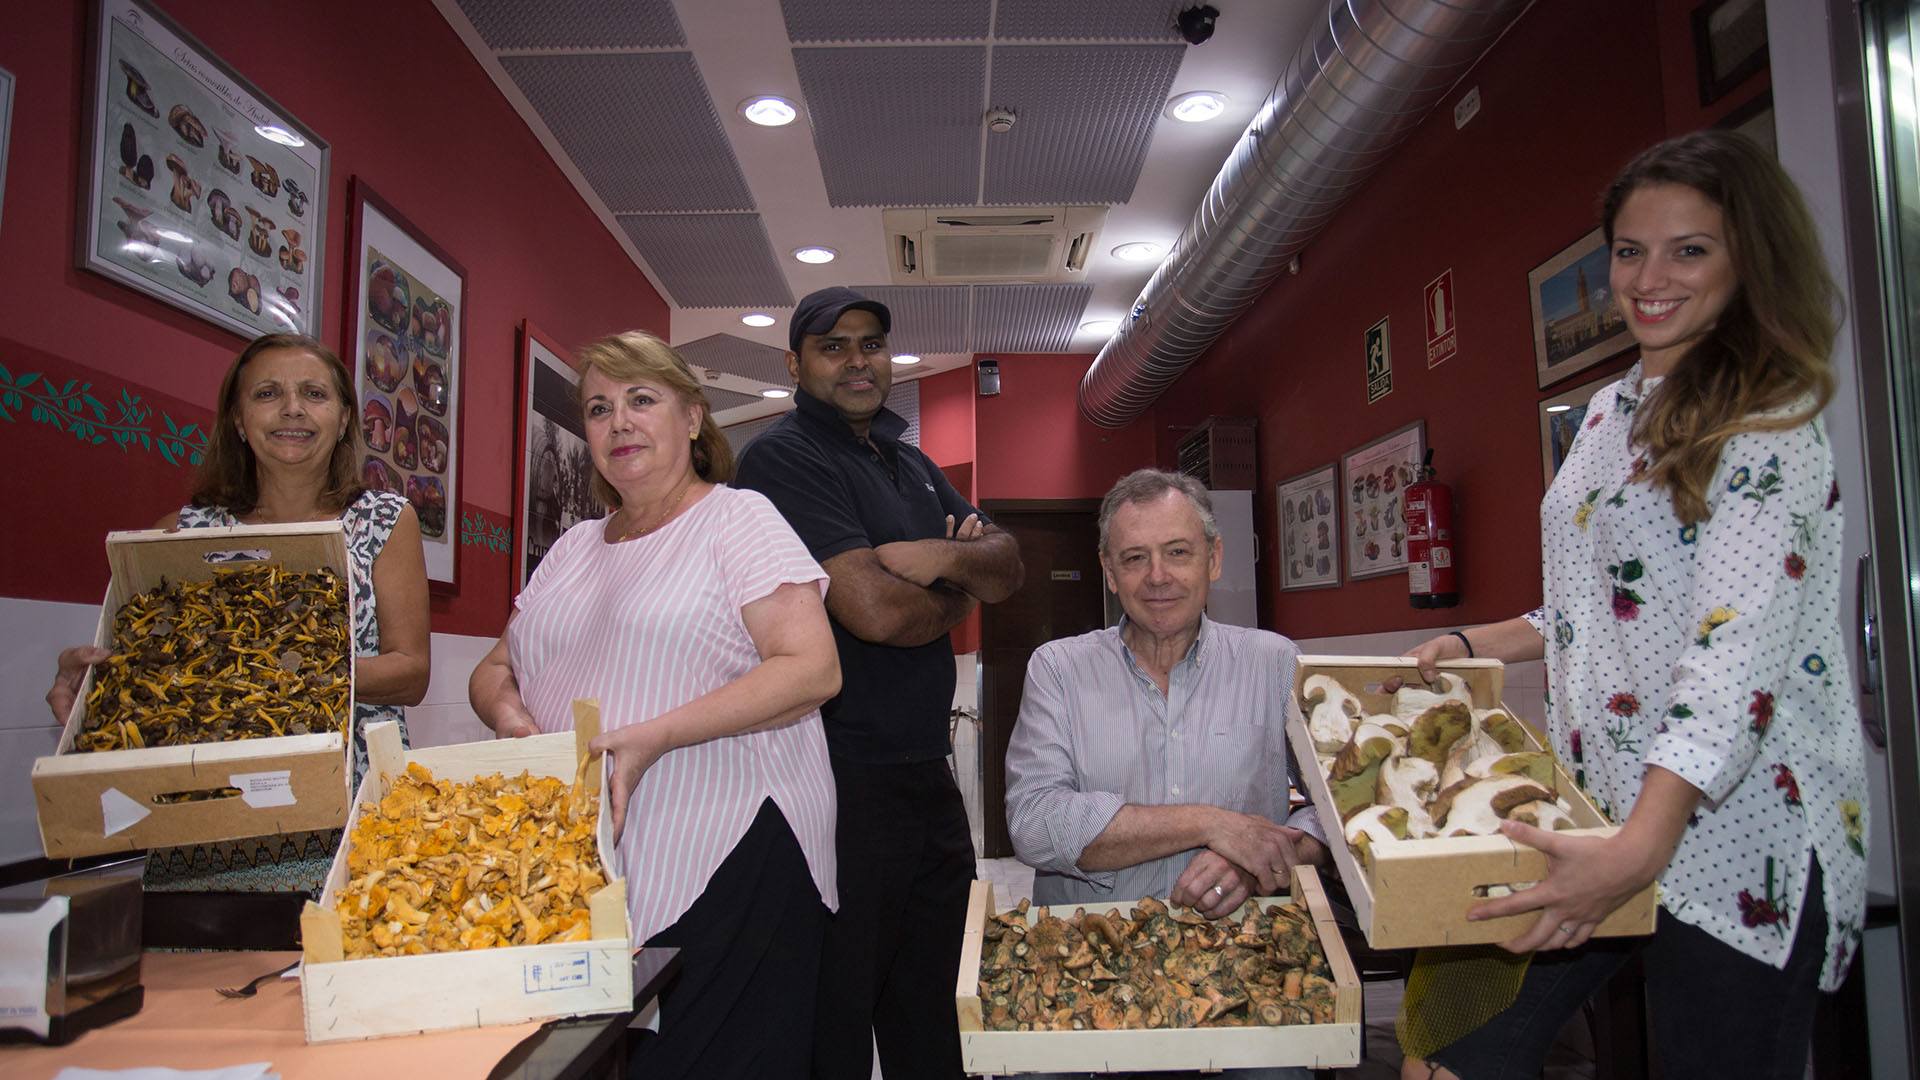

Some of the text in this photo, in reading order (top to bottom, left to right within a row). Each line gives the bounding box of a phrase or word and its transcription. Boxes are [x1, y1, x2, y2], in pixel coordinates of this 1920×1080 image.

[174, 47, 198, 73] Setas
[1429, 335, 1456, 361] EXTINTOR
[1370, 376, 1390, 394] SALIDA
